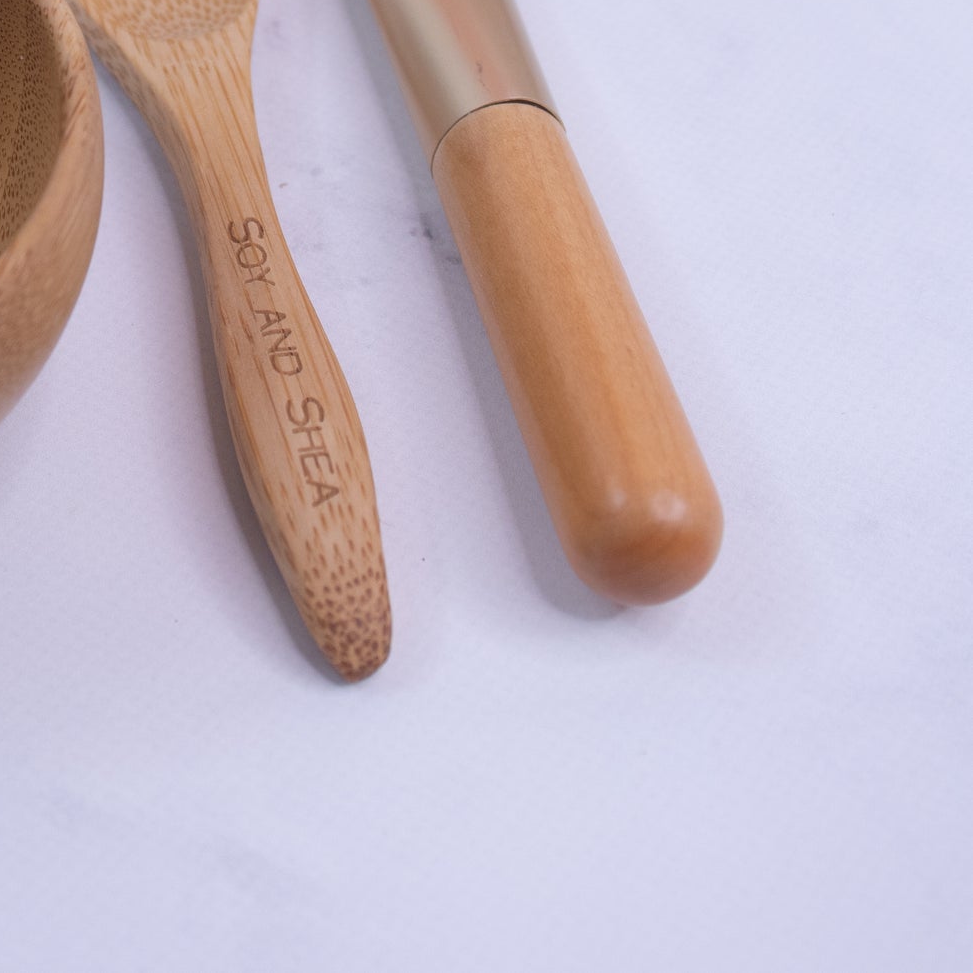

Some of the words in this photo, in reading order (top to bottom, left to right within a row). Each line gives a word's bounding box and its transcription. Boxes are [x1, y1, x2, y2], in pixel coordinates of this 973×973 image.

[227, 217, 275, 287] SOY
[252, 307, 303, 377] AND
[286, 396, 340, 507] SHEA
